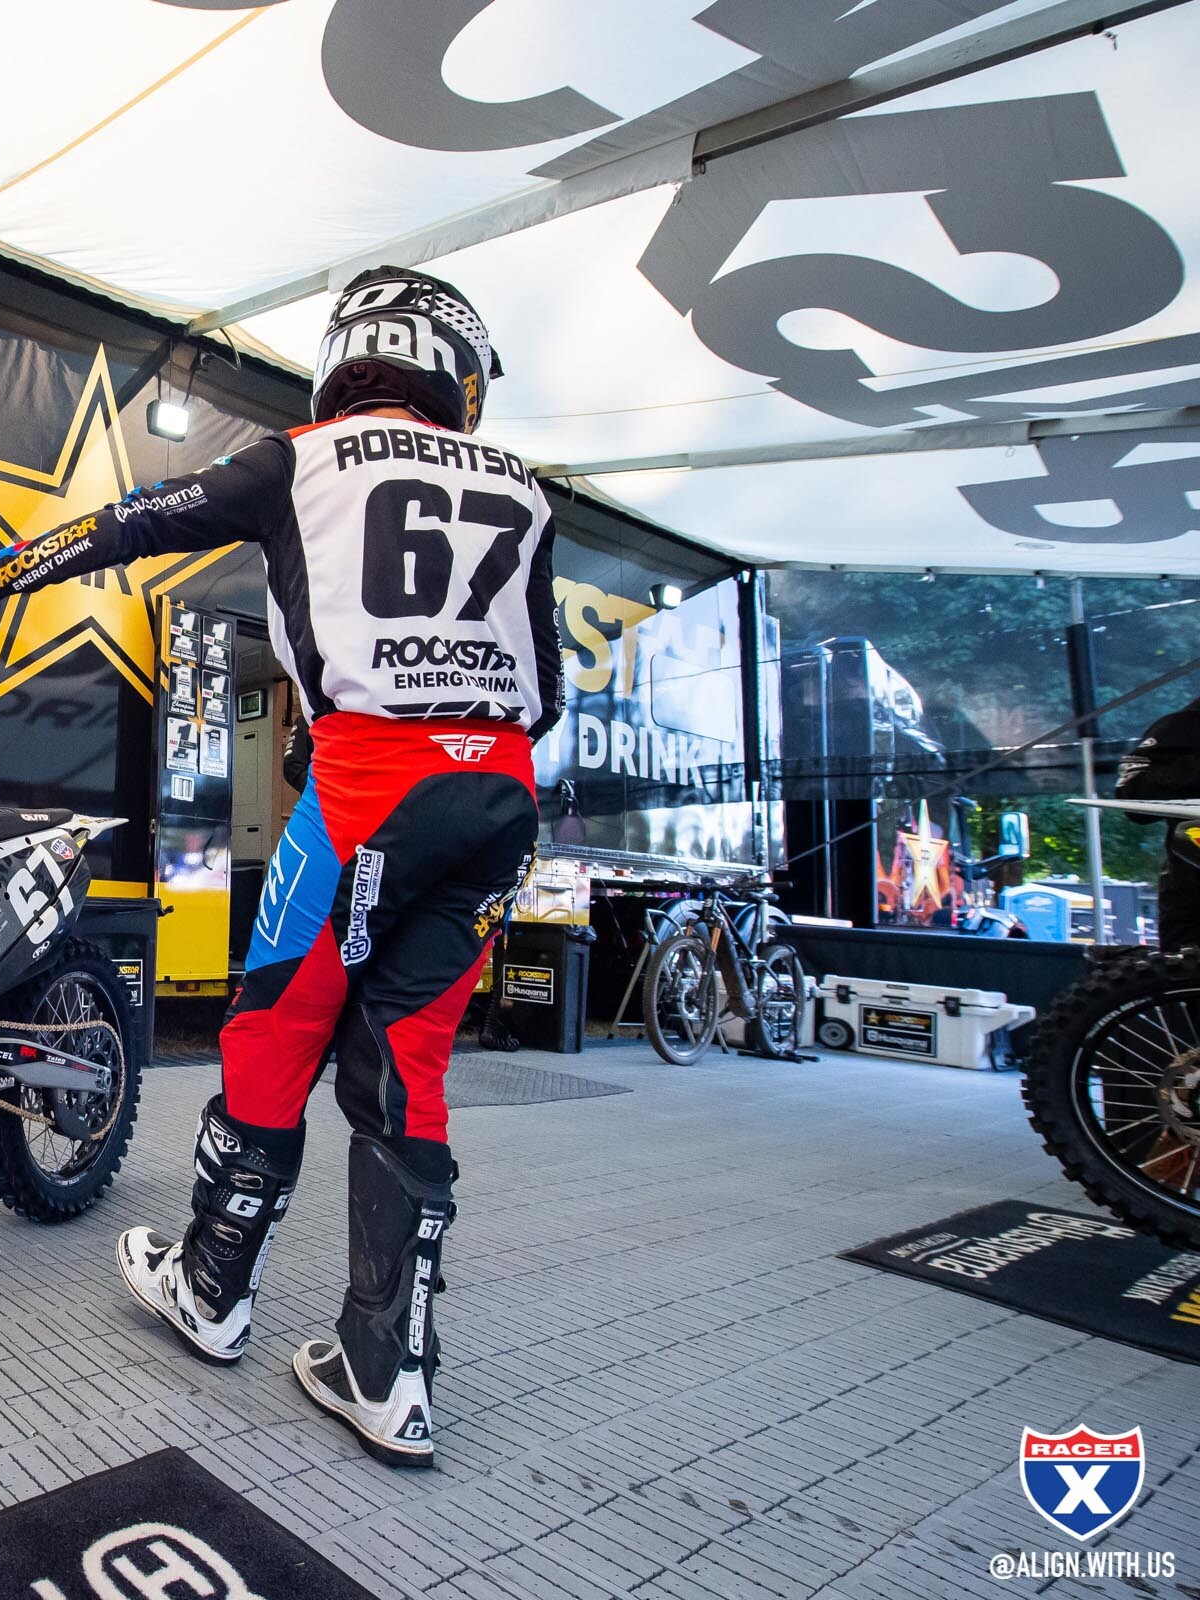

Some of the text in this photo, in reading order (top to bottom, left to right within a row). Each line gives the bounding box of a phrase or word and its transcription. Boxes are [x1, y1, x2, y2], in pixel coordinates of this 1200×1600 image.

[12, 560, 54, 592] ENERGY
[56, 537, 94, 569] DRINK
[361, 478, 533, 622] 67
[578, 712, 704, 789] DRINK
[6, 843, 75, 945] 67
[349, 851, 373, 941] Husqvarna
[513, 986, 549, 998] Husqvarna
[225, 1193, 263, 1218] G
[417, 1217, 444, 1241] 67
[408, 1255, 432, 1357] GAERNE
[404, 1421, 425, 1440] G
